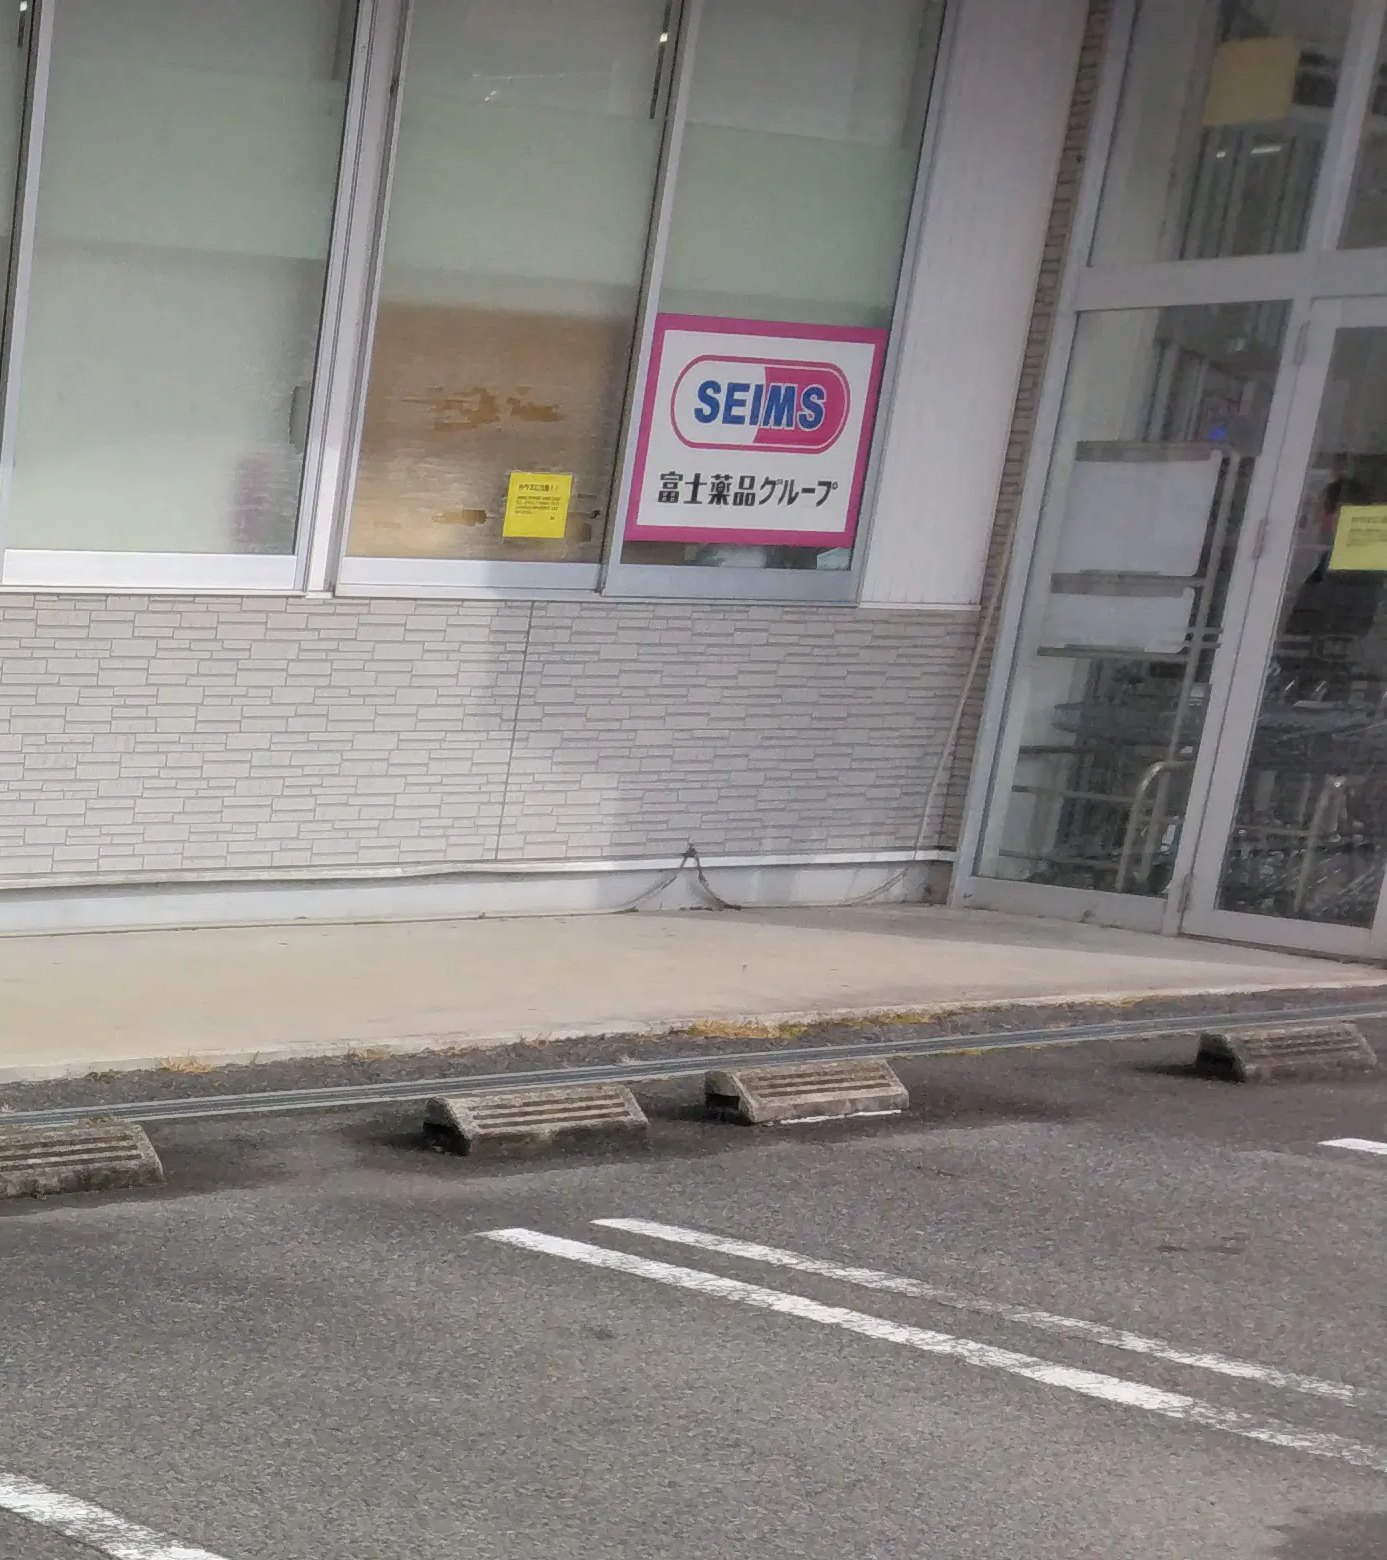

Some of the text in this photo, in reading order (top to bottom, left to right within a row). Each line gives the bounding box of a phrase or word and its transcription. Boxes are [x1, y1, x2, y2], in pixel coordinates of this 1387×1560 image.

[693, 379, 827, 430] SEIMS
[657, 470, 839, 508] 富士薬品グループ
